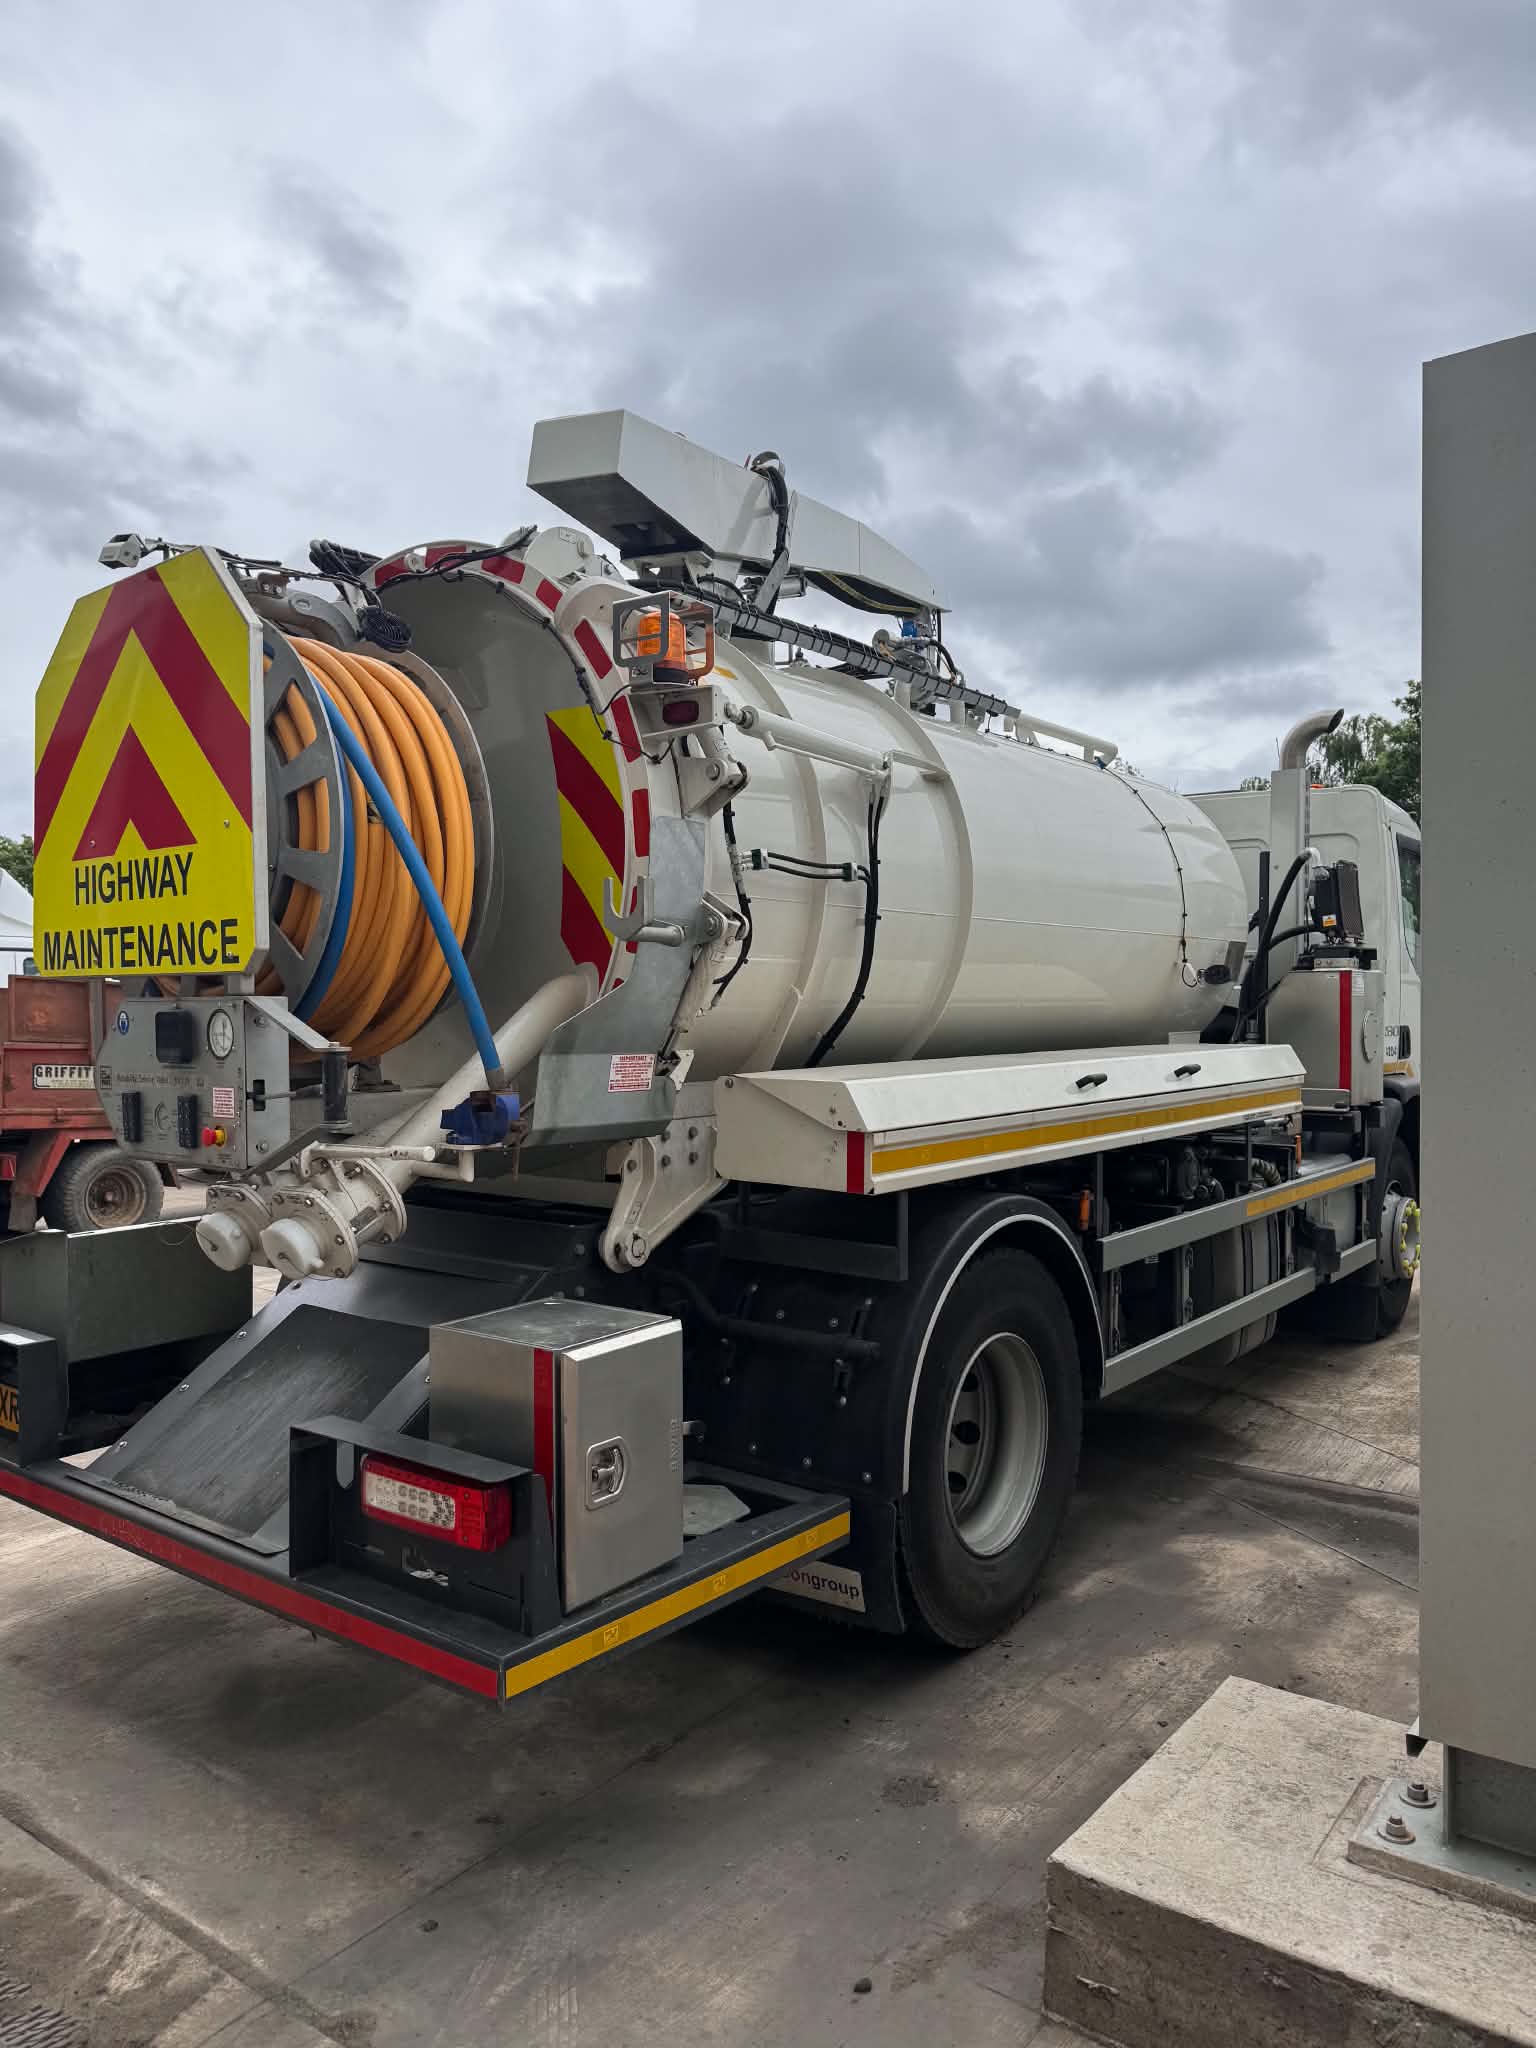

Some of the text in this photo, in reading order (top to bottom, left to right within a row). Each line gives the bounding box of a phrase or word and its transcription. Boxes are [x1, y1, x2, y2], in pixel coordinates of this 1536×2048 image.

[75, 851, 194, 906] HIGHWAY
[43, 918, 241, 970] MAINTENANCE
[35, 1066, 96, 1079] GRIFFIT
[783, 1567, 860, 1600] ongroup
